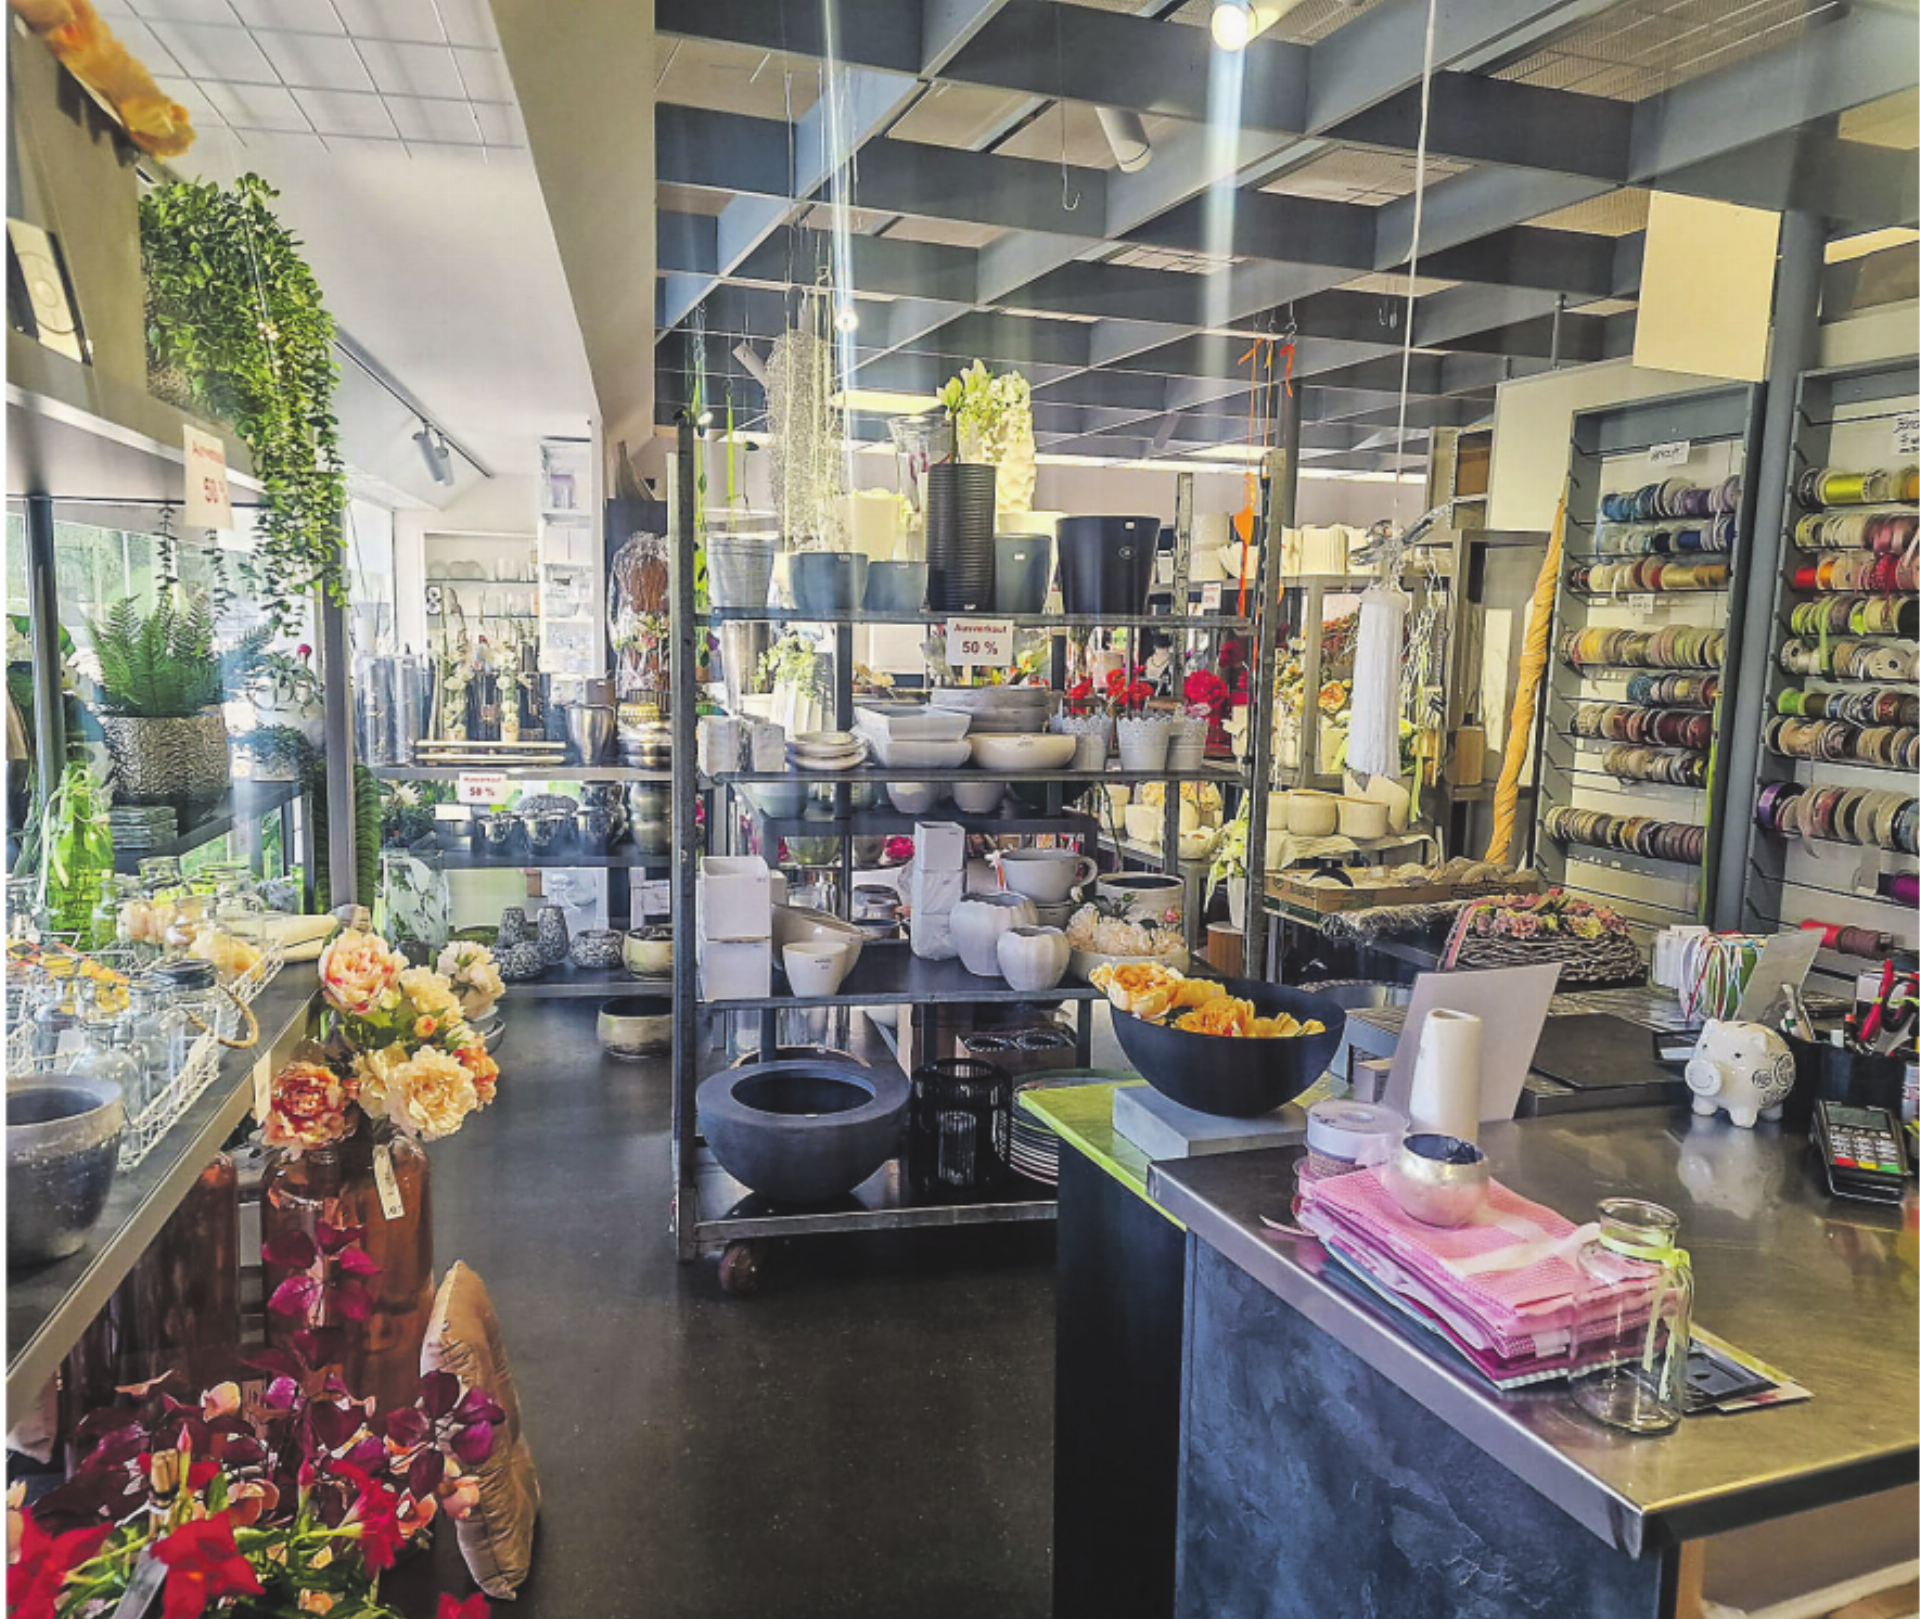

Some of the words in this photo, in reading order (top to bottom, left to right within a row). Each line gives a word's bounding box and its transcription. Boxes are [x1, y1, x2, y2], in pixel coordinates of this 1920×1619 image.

[962, 640, 980, 654] 50
[984, 640, 999, 655] %
[470, 786, 482, 797] 50
